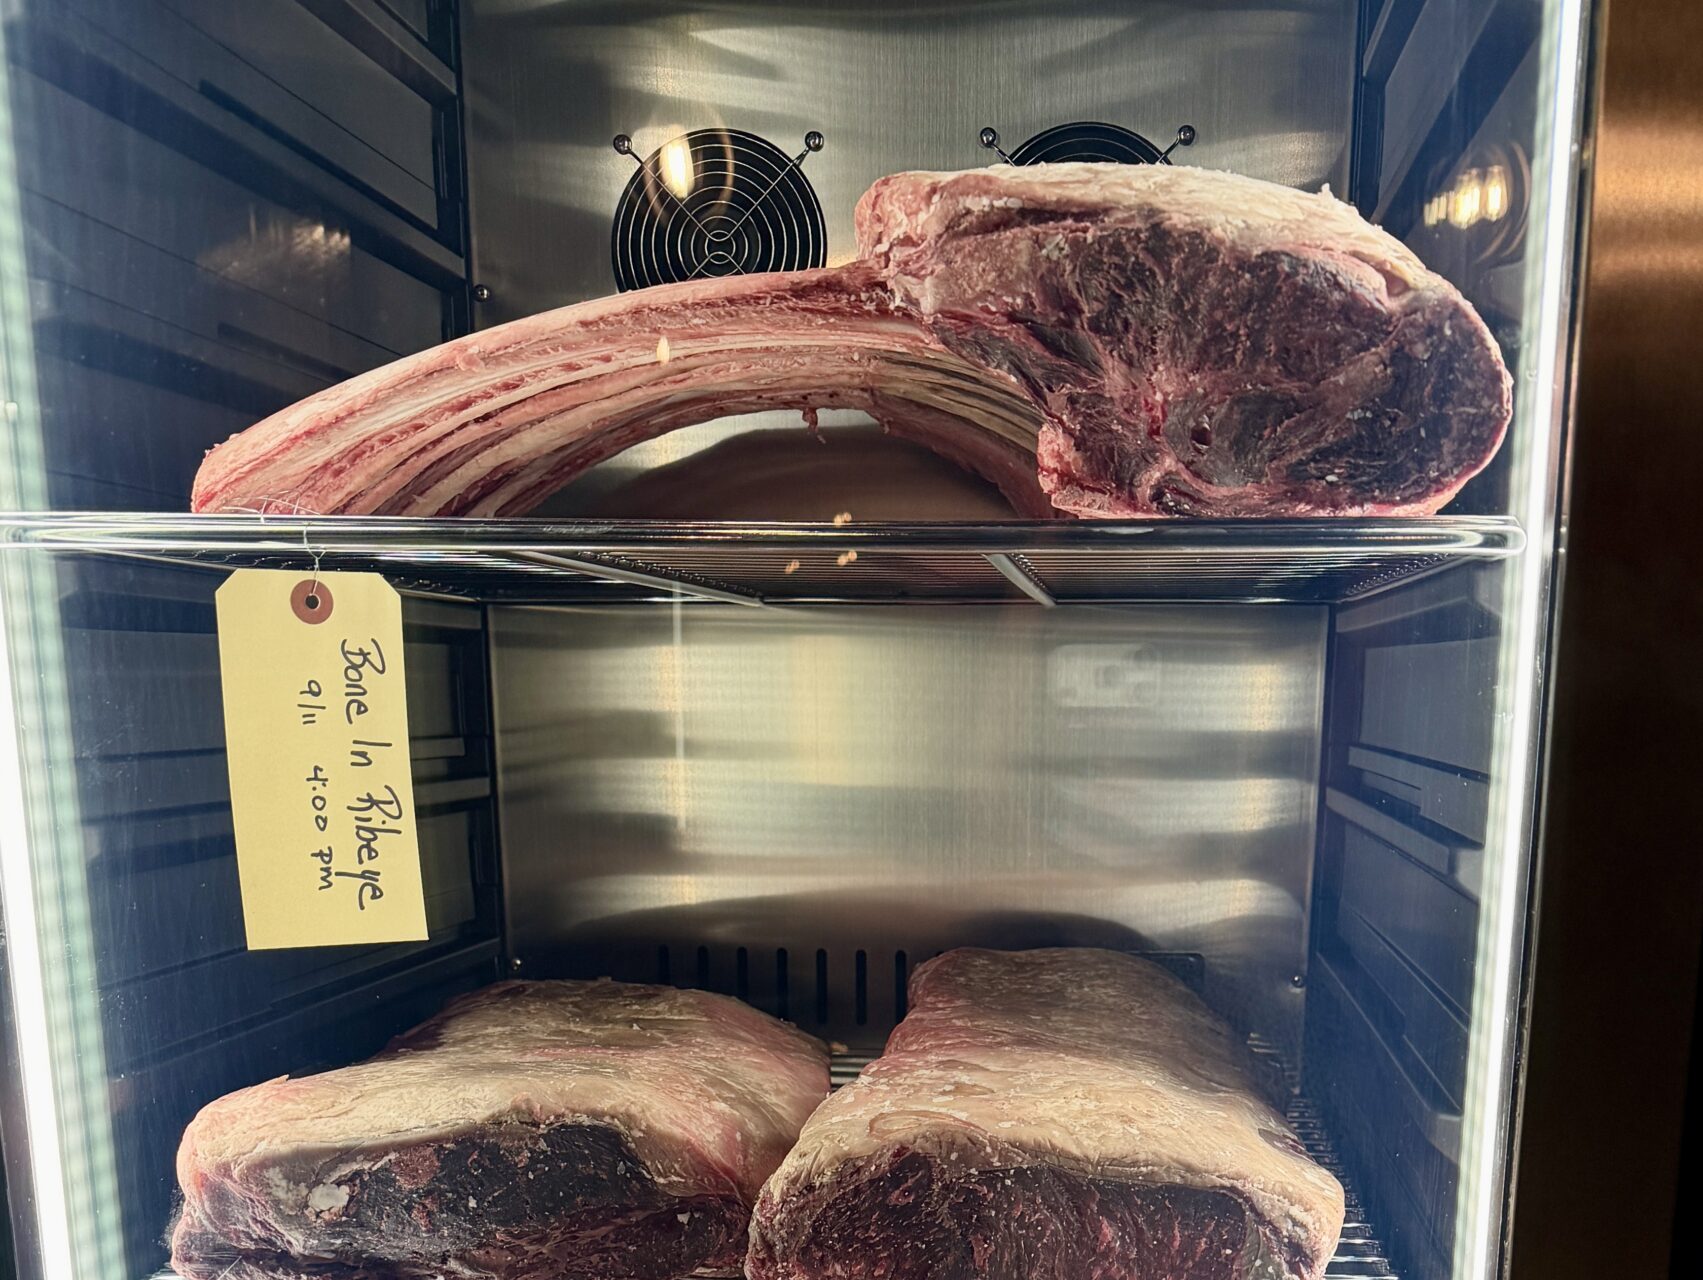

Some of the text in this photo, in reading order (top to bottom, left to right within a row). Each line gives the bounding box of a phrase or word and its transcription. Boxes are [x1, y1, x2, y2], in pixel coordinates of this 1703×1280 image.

[296, 678, 327, 726] 9/11
[306, 764, 329, 833] 4:00
[334, 637, 403, 912] Bone In Ribeye
